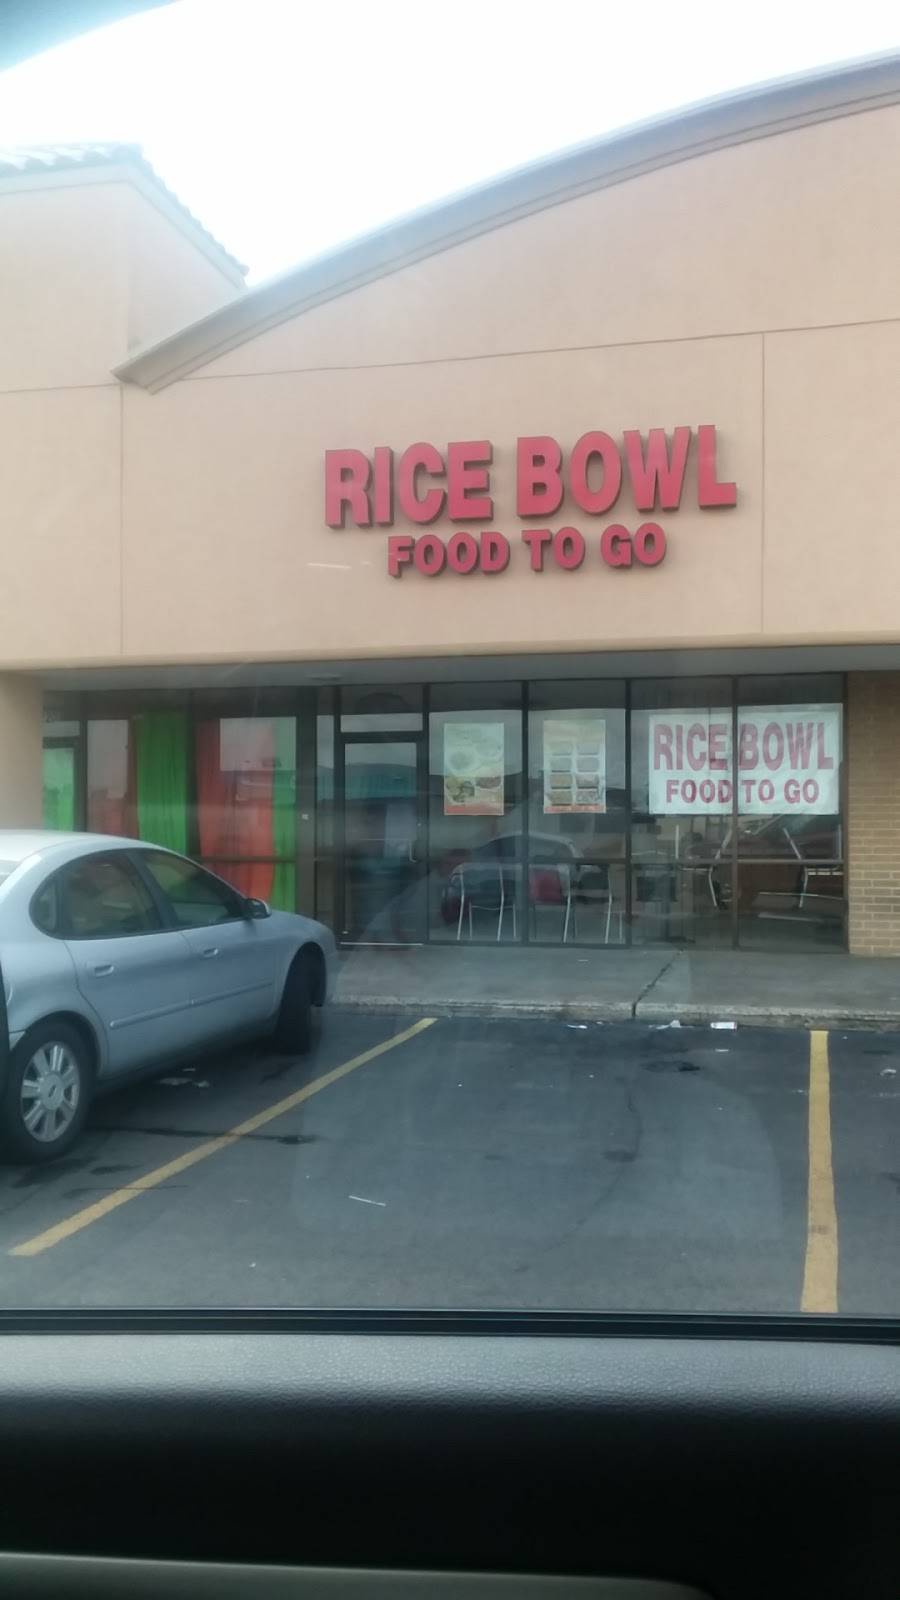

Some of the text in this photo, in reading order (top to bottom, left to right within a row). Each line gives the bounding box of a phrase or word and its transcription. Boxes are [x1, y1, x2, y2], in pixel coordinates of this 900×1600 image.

[325, 425, 737, 528] RICE BOWL
[388, 522, 667, 577] FOOD TO GO
[653, 722, 834, 771] RICE BOWL
[665, 779, 820, 804] FOOD TO GO
